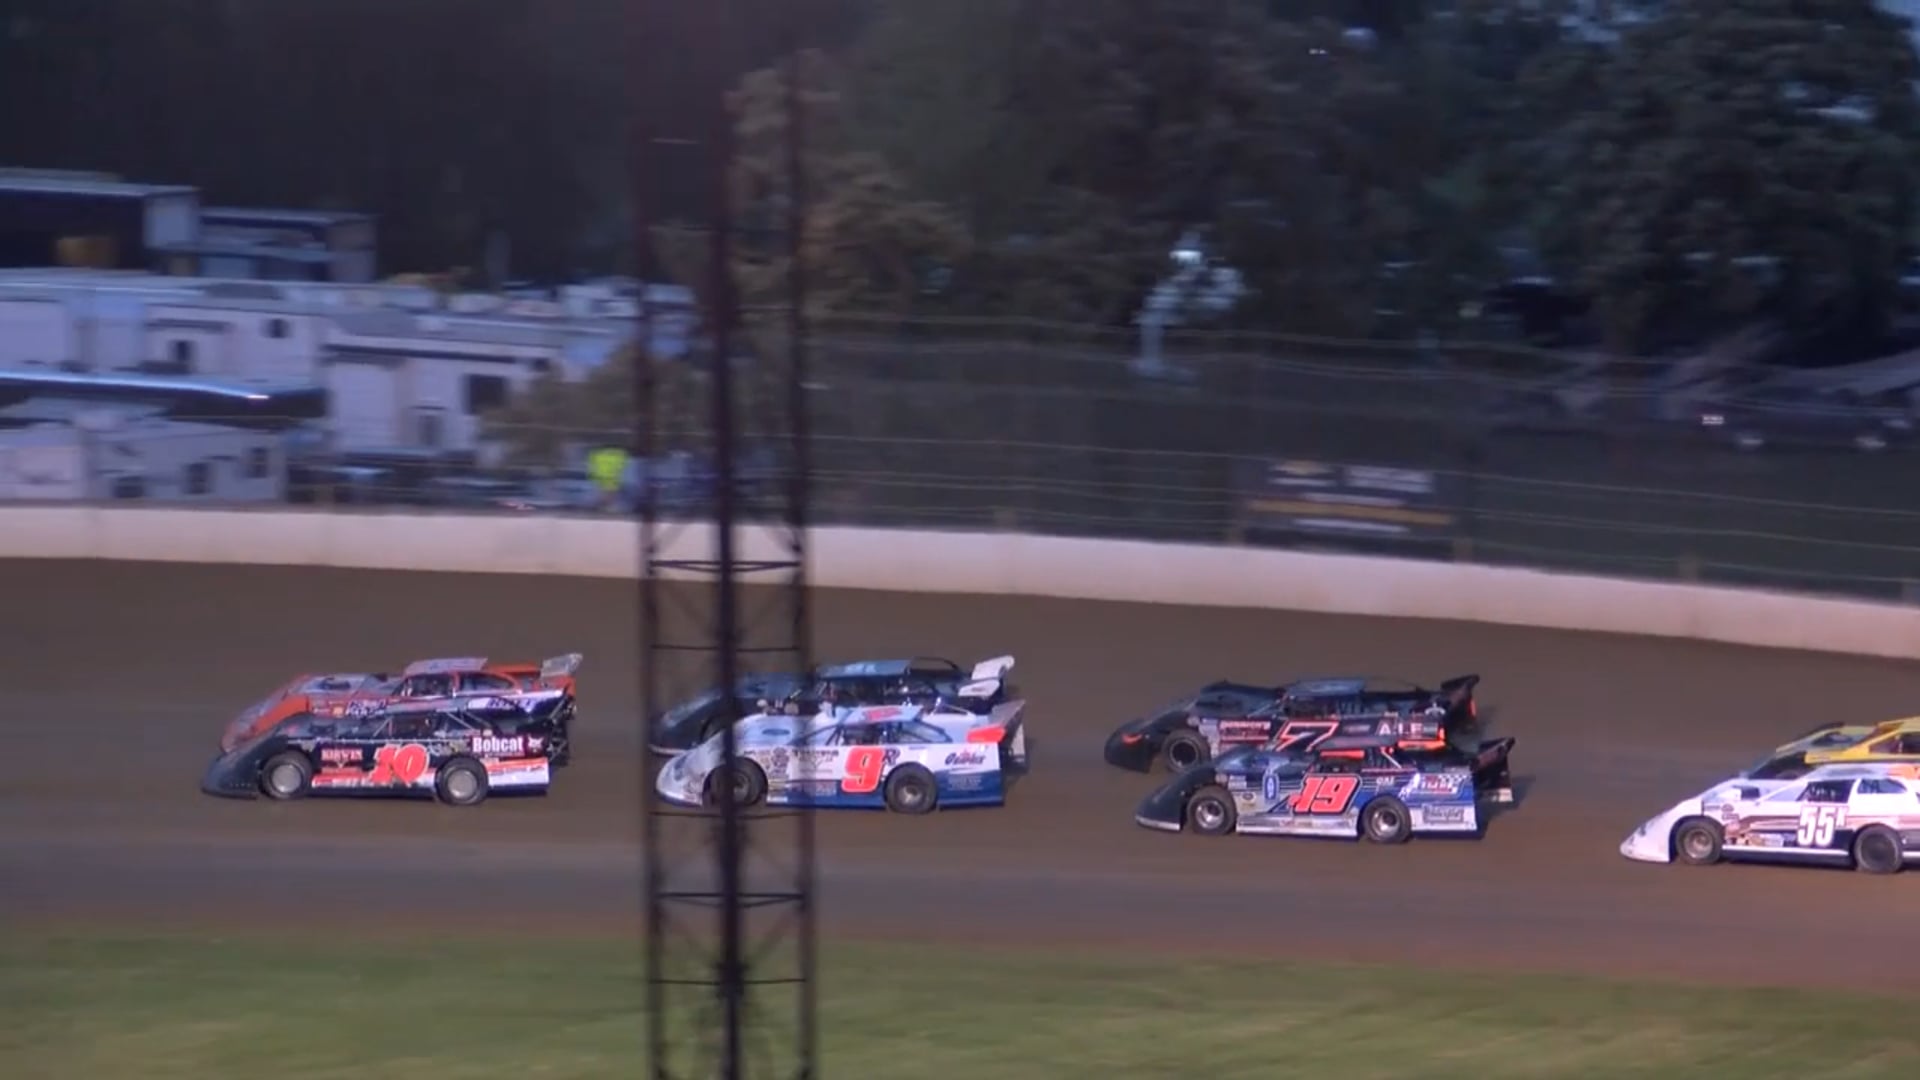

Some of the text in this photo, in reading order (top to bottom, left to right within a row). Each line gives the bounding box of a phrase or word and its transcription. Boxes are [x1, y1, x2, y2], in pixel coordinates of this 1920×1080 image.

[472, 736, 524, 753] Bobcat
[1275, 721, 1339, 752] 7
[368, 744, 430, 787] 10
[1289, 775, 1359, 813] 19
